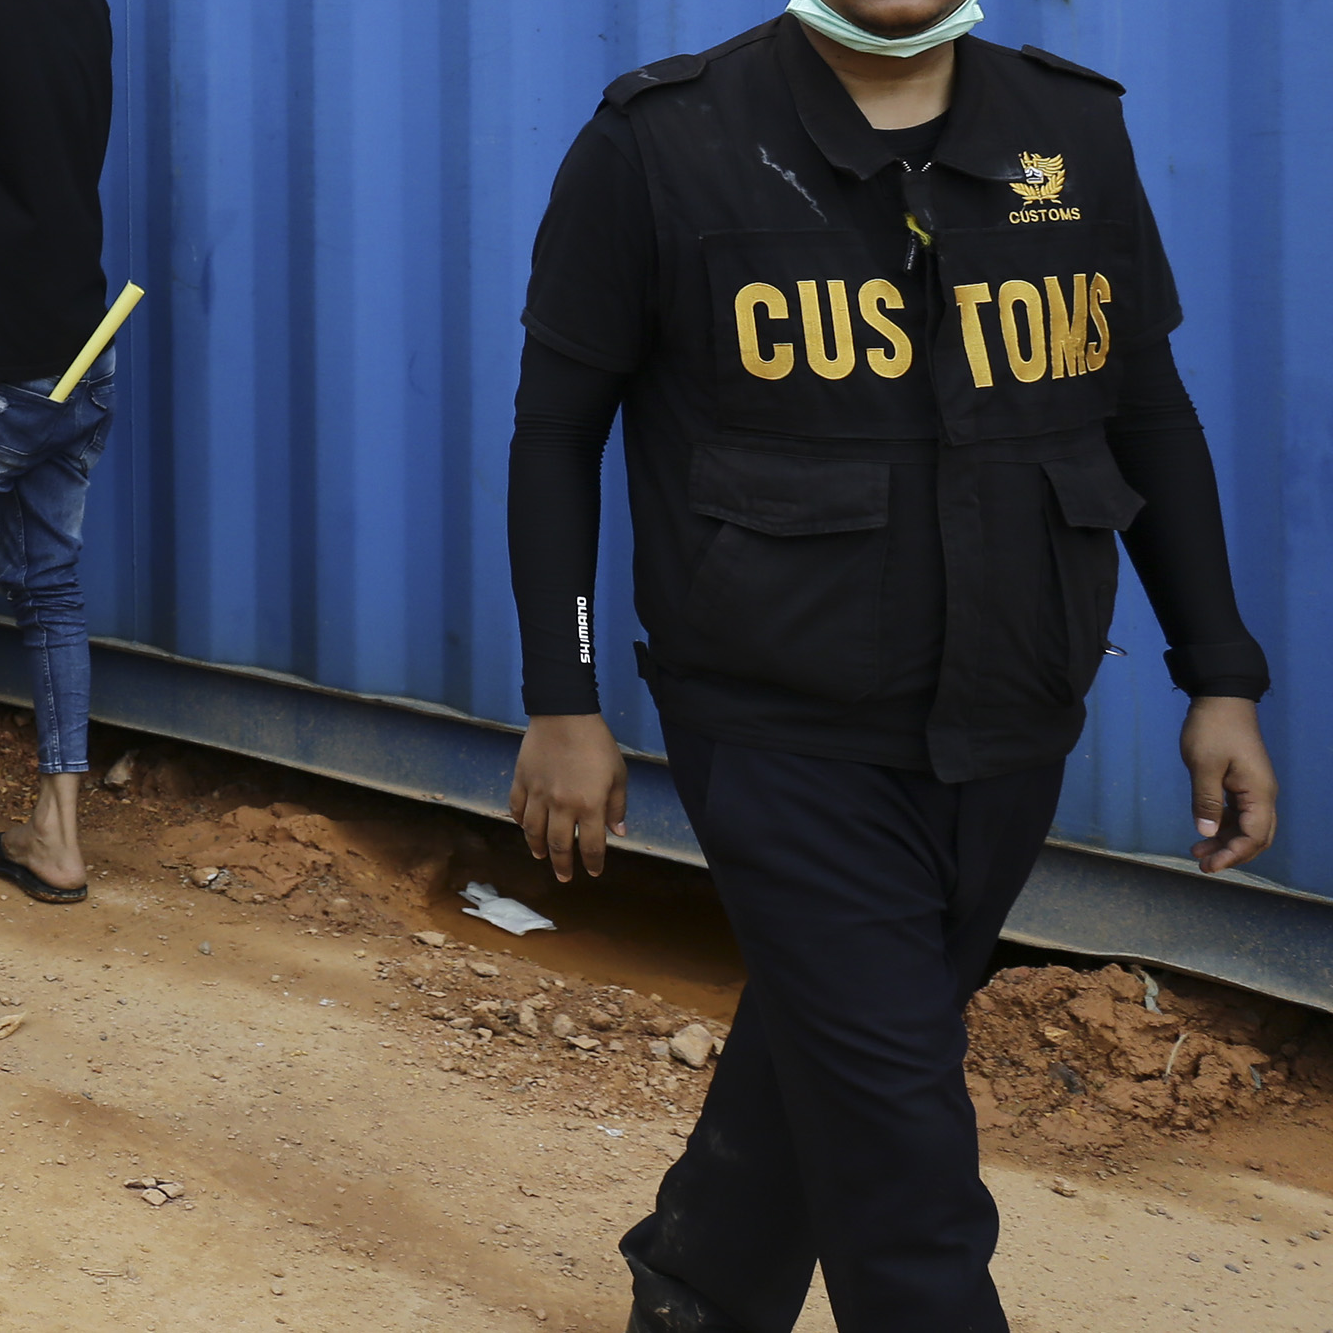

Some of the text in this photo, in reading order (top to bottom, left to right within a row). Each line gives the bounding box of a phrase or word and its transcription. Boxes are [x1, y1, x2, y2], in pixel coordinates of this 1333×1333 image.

[1009, 207, 1081, 224] CUSTOMS
[734, 272, 1112, 388] CUS TOMS
[576, 596, 591, 664] SHIMANO
